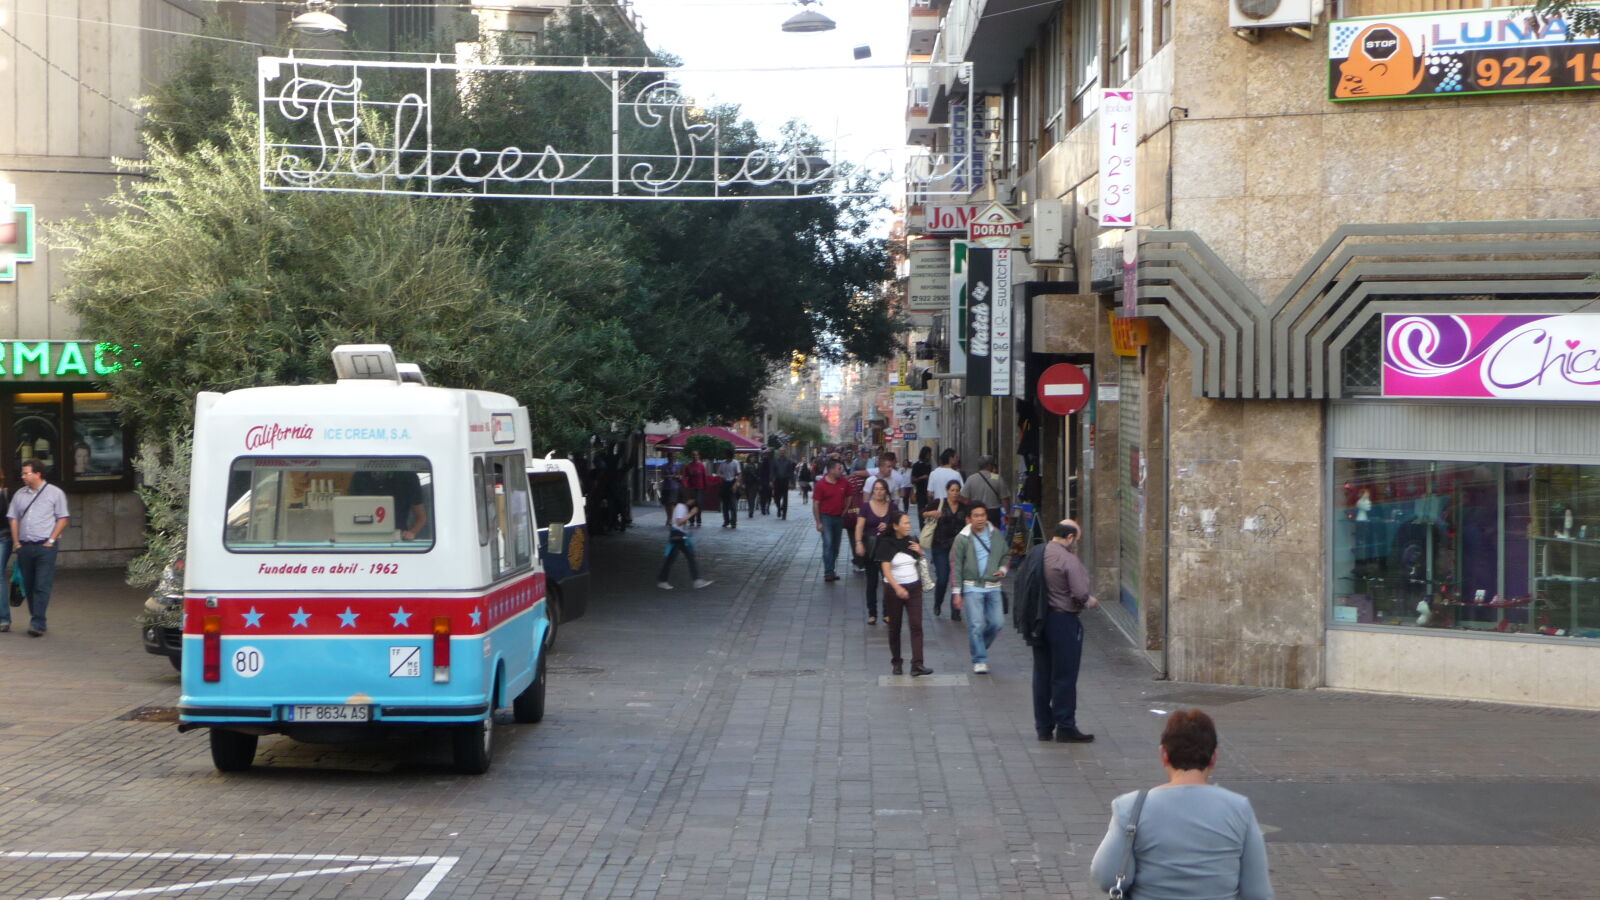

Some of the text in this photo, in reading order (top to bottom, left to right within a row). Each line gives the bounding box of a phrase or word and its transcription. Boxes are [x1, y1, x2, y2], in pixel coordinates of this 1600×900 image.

[1366, 40, 1396, 48] STOP
[1476, 55, 1552, 87] 922
[277, 76, 597, 187] Felices
[973, 224, 1018, 236] DORADA
[997, 259, 1008, 308] swatch
[970, 302, 990, 357] Watch
[0, 342, 125, 376] MAC
[245, 423, 314, 450] California
[324, 428, 342, 440] ICE
[391, 428, 411, 440] S.A.
[375, 506, 386, 523] 9
[258, 563, 307, 574] Fundada
[311, 565, 325, 574] en
[329, 563, 358, 574] abril
[369, 563, 399, 574] 1962
[236, 651, 259, 672] 80
[297, 706, 367, 720] TF 8634 AS
